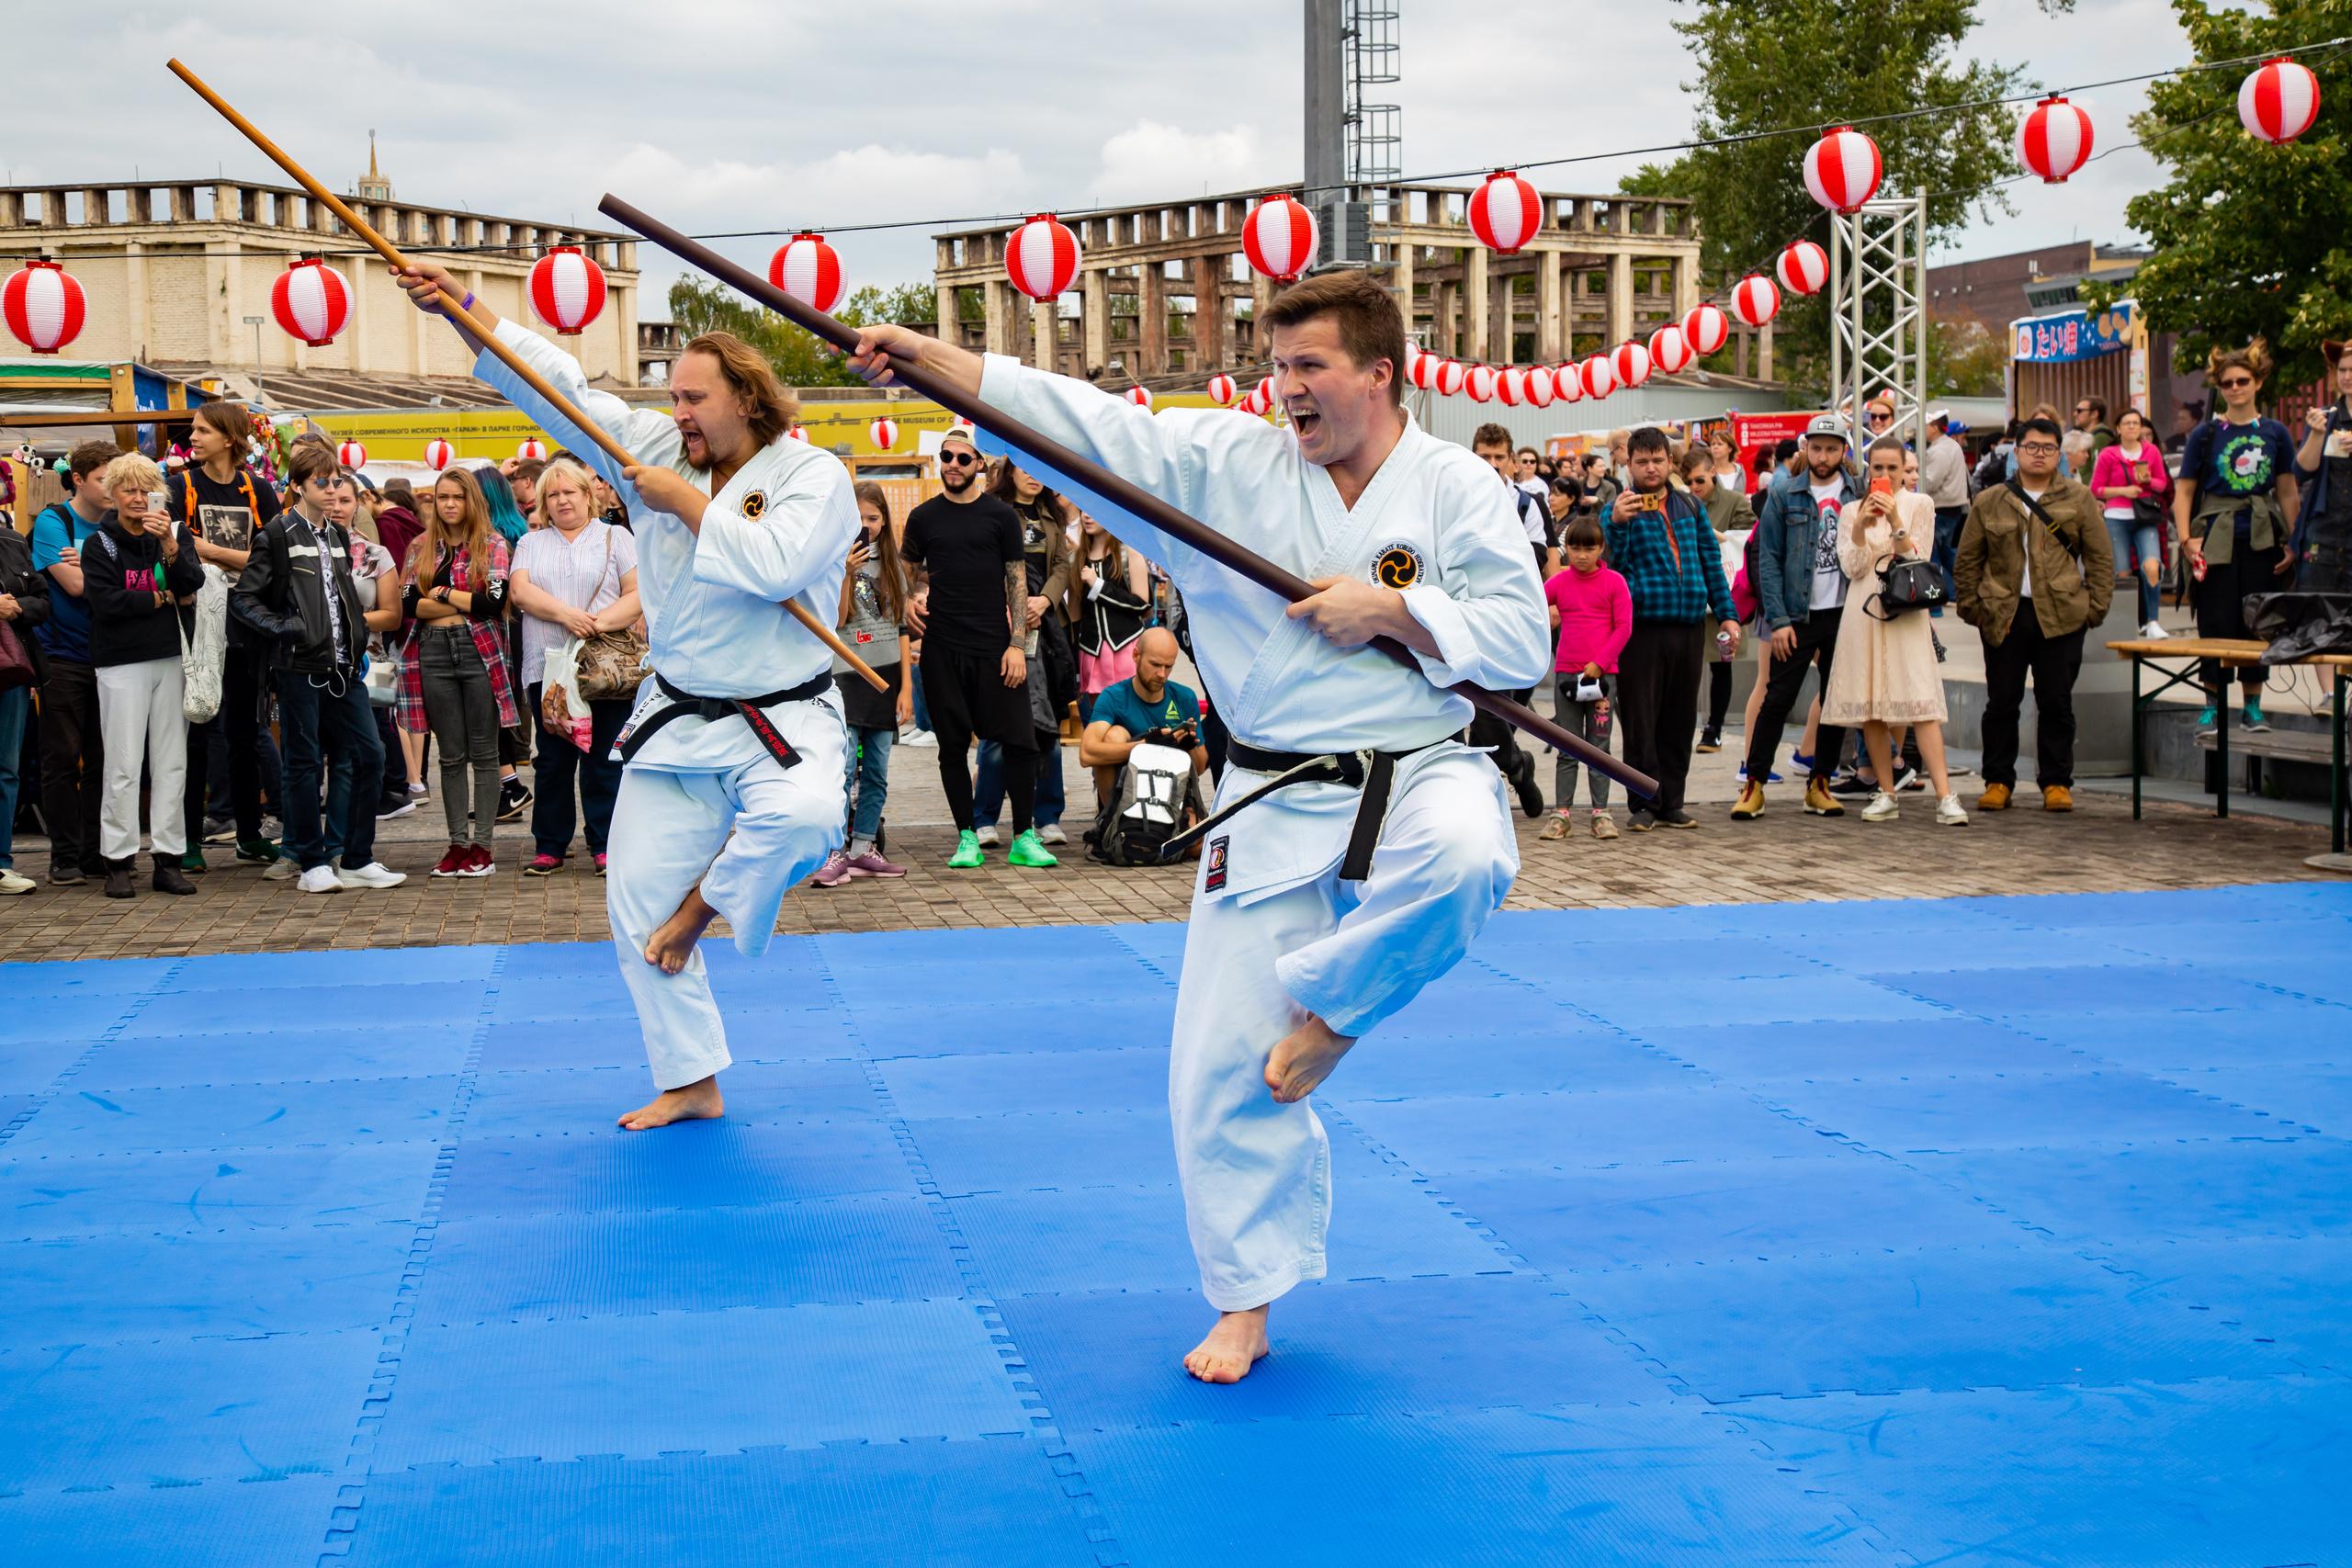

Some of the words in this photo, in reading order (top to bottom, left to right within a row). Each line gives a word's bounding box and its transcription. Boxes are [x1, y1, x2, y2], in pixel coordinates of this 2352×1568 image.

[2034, 321, 2078, 358] たい焼
[903, 416, 935, 424] MUSEUM
[355, 427, 410, 436] СОВРЕМЕННОГО
[411, 426, 450, 434] ИСКУССТВА
[488, 424, 511, 433] ПАРКЕ
[1374, 543, 1396, 560] KARATE
[1396, 543, 1415, 555] KOBUDO
